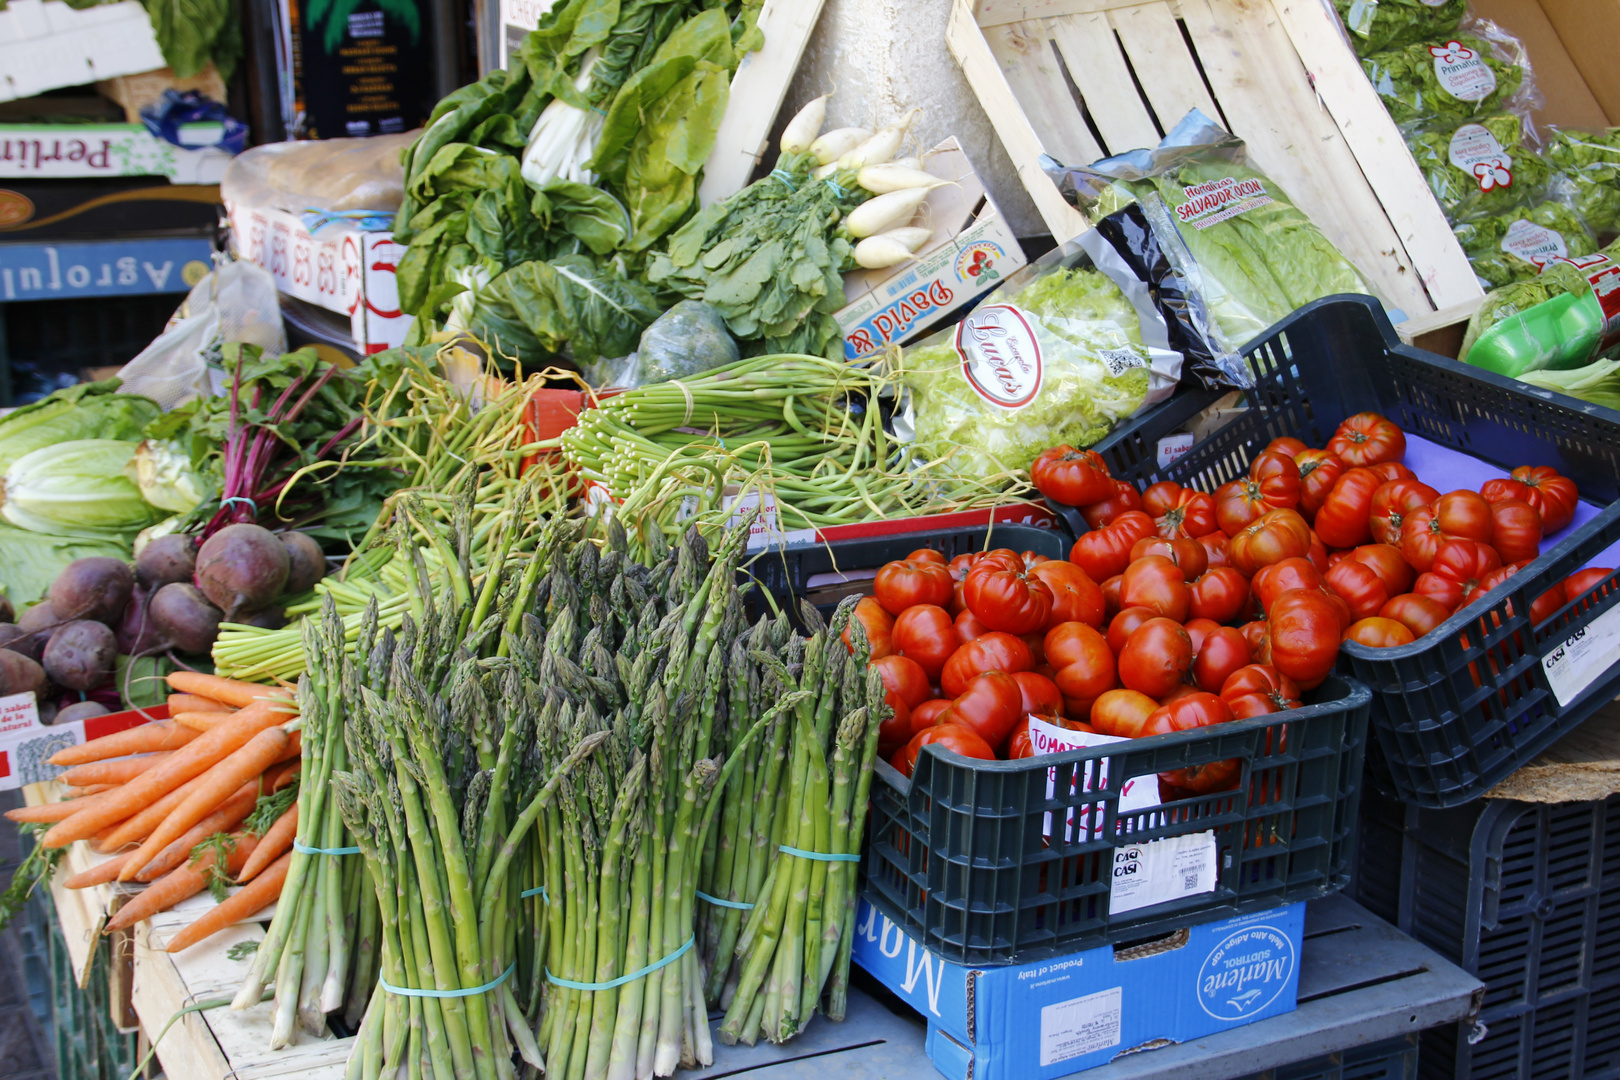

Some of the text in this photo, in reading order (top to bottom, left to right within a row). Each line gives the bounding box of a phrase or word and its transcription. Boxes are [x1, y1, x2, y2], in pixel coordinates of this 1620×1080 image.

[1177, 180, 1262, 220] SALVADOR OCON
[1185, 178, 1233, 198] Hortalizas
[874, 278, 954, 343] David
[845, 331, 874, 356] &
[967, 314, 1022, 397] Lucas
[1546, 648, 1565, 668] CASI
[0, 719, 32, 732] atural
[1031, 727, 1088, 754] TOMAT
[1115, 850, 1138, 862] CASI
[1113, 862, 1137, 877] CASI
[856, 904, 945, 1017] Mar
[1210, 931, 1284, 966] Mela Alto Adige IGP
[1223, 949, 1270, 968] SÜDTIROL
[1017, 957, 1082, 980] Product of Italy
[1203, 955, 1287, 993] Marlene
